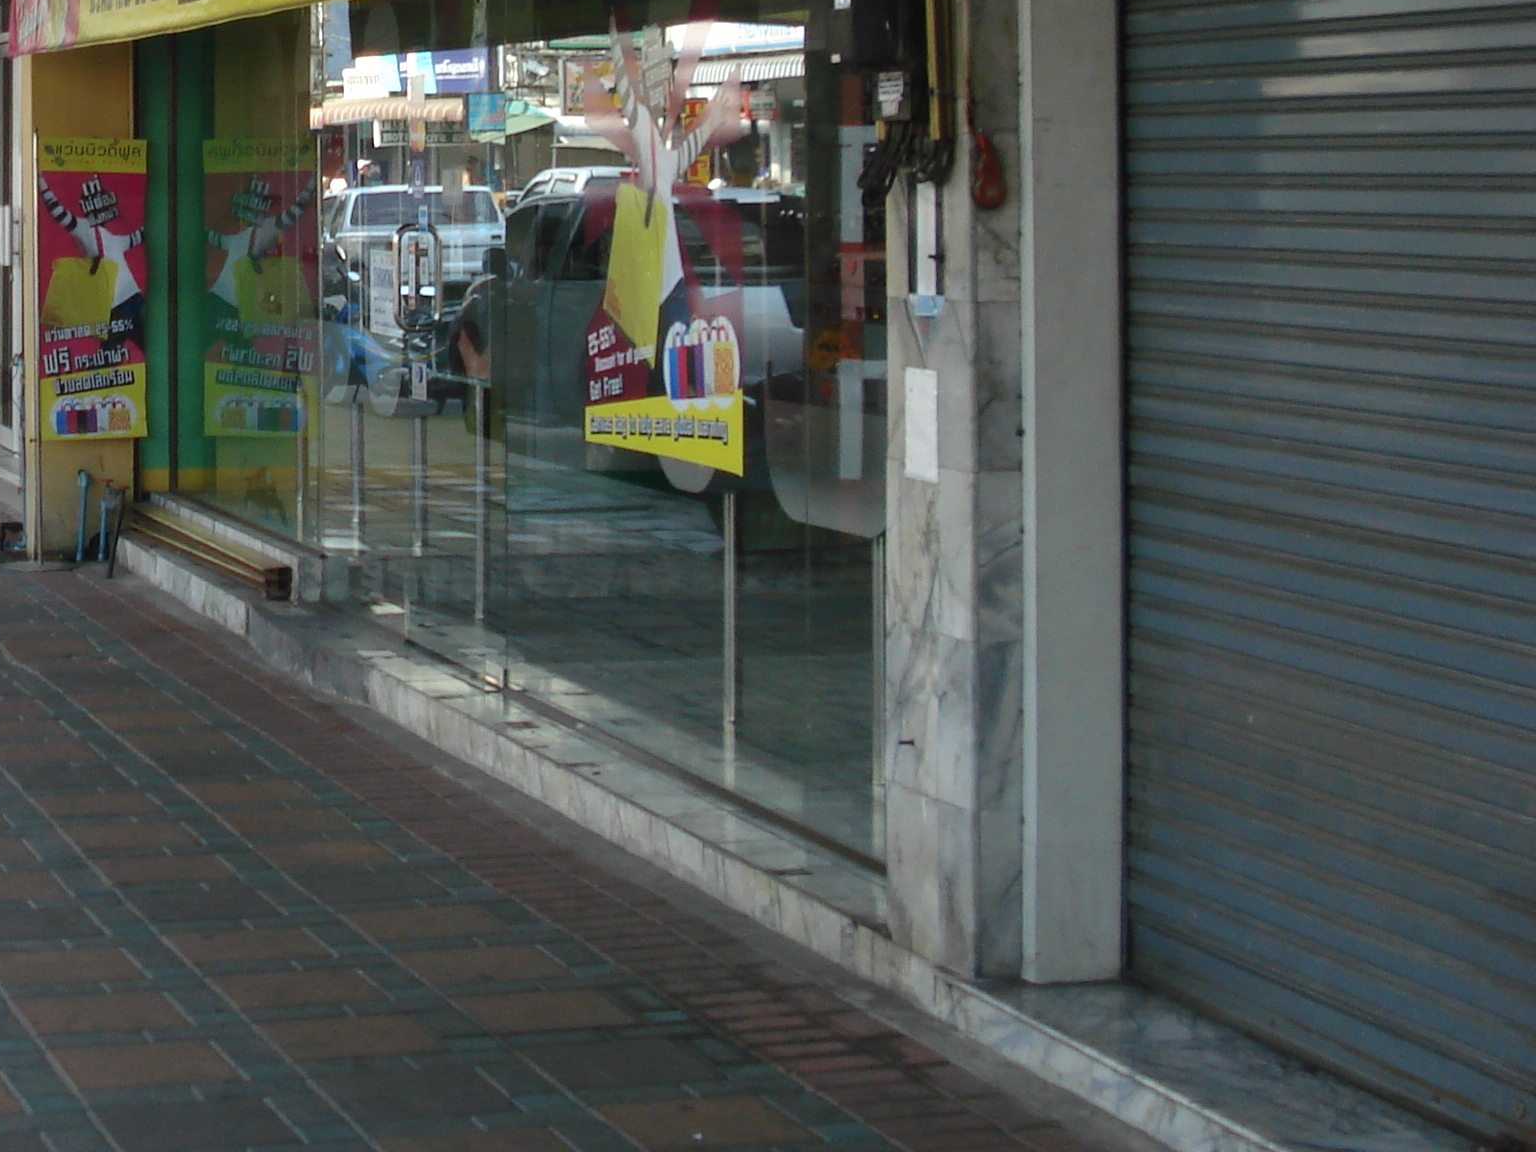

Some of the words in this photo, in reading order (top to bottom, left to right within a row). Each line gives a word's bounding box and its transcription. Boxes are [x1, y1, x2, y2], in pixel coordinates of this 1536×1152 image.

[95, 318, 134, 336] 25-55%
[42, 345, 71, 375] ฟรี
[603, 373, 623, 398] Free!
[673, 414, 696, 442] global
